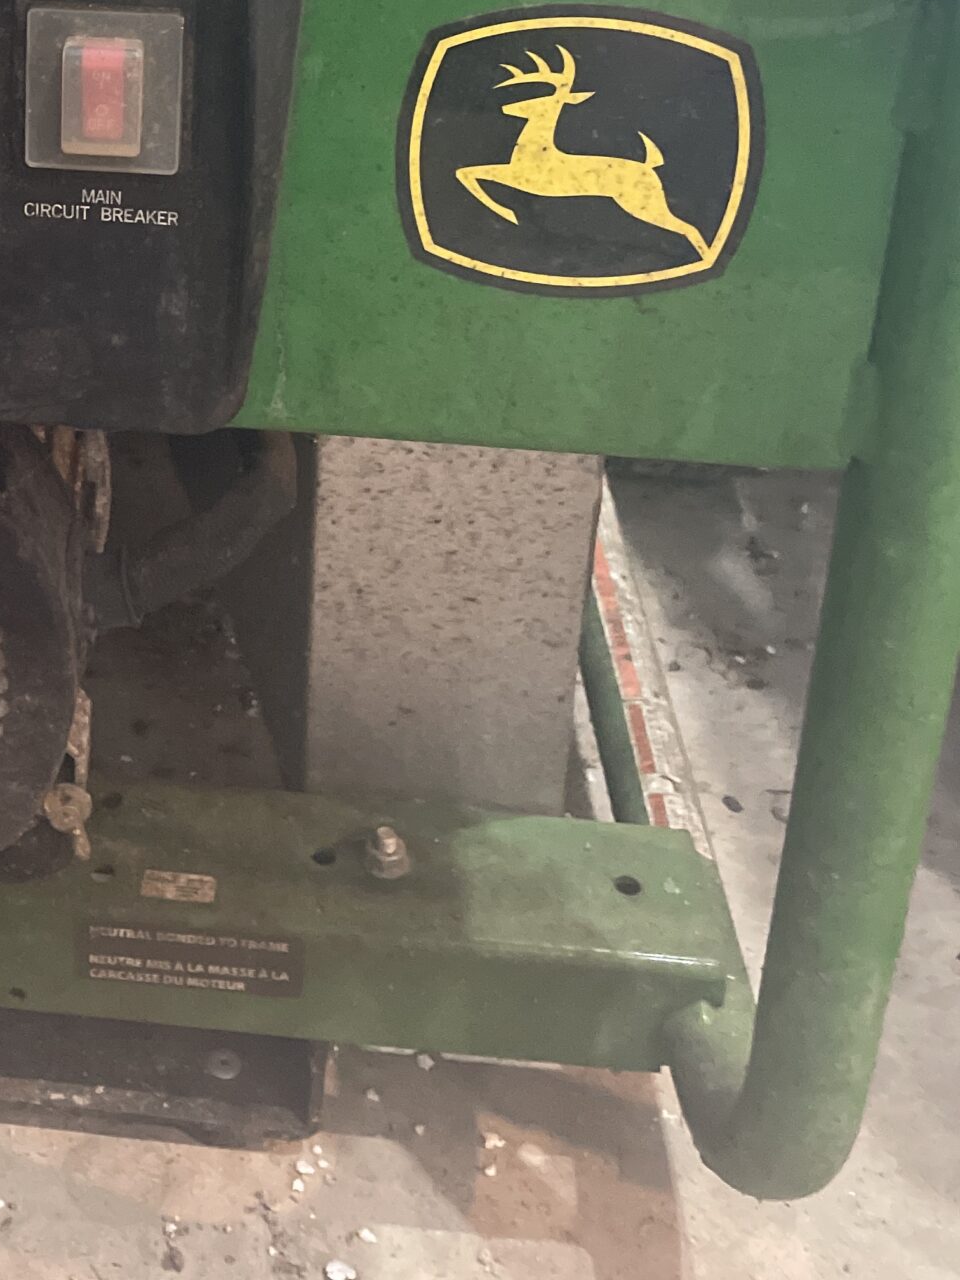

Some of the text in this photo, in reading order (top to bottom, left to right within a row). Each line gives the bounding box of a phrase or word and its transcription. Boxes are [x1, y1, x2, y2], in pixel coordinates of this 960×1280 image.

[81, 189, 122, 206] MAIN
[23, 202, 179, 227] CIRCUIT BREAKER
[187, 963, 205, 974] LA
[163, 974, 183, 986] DU
